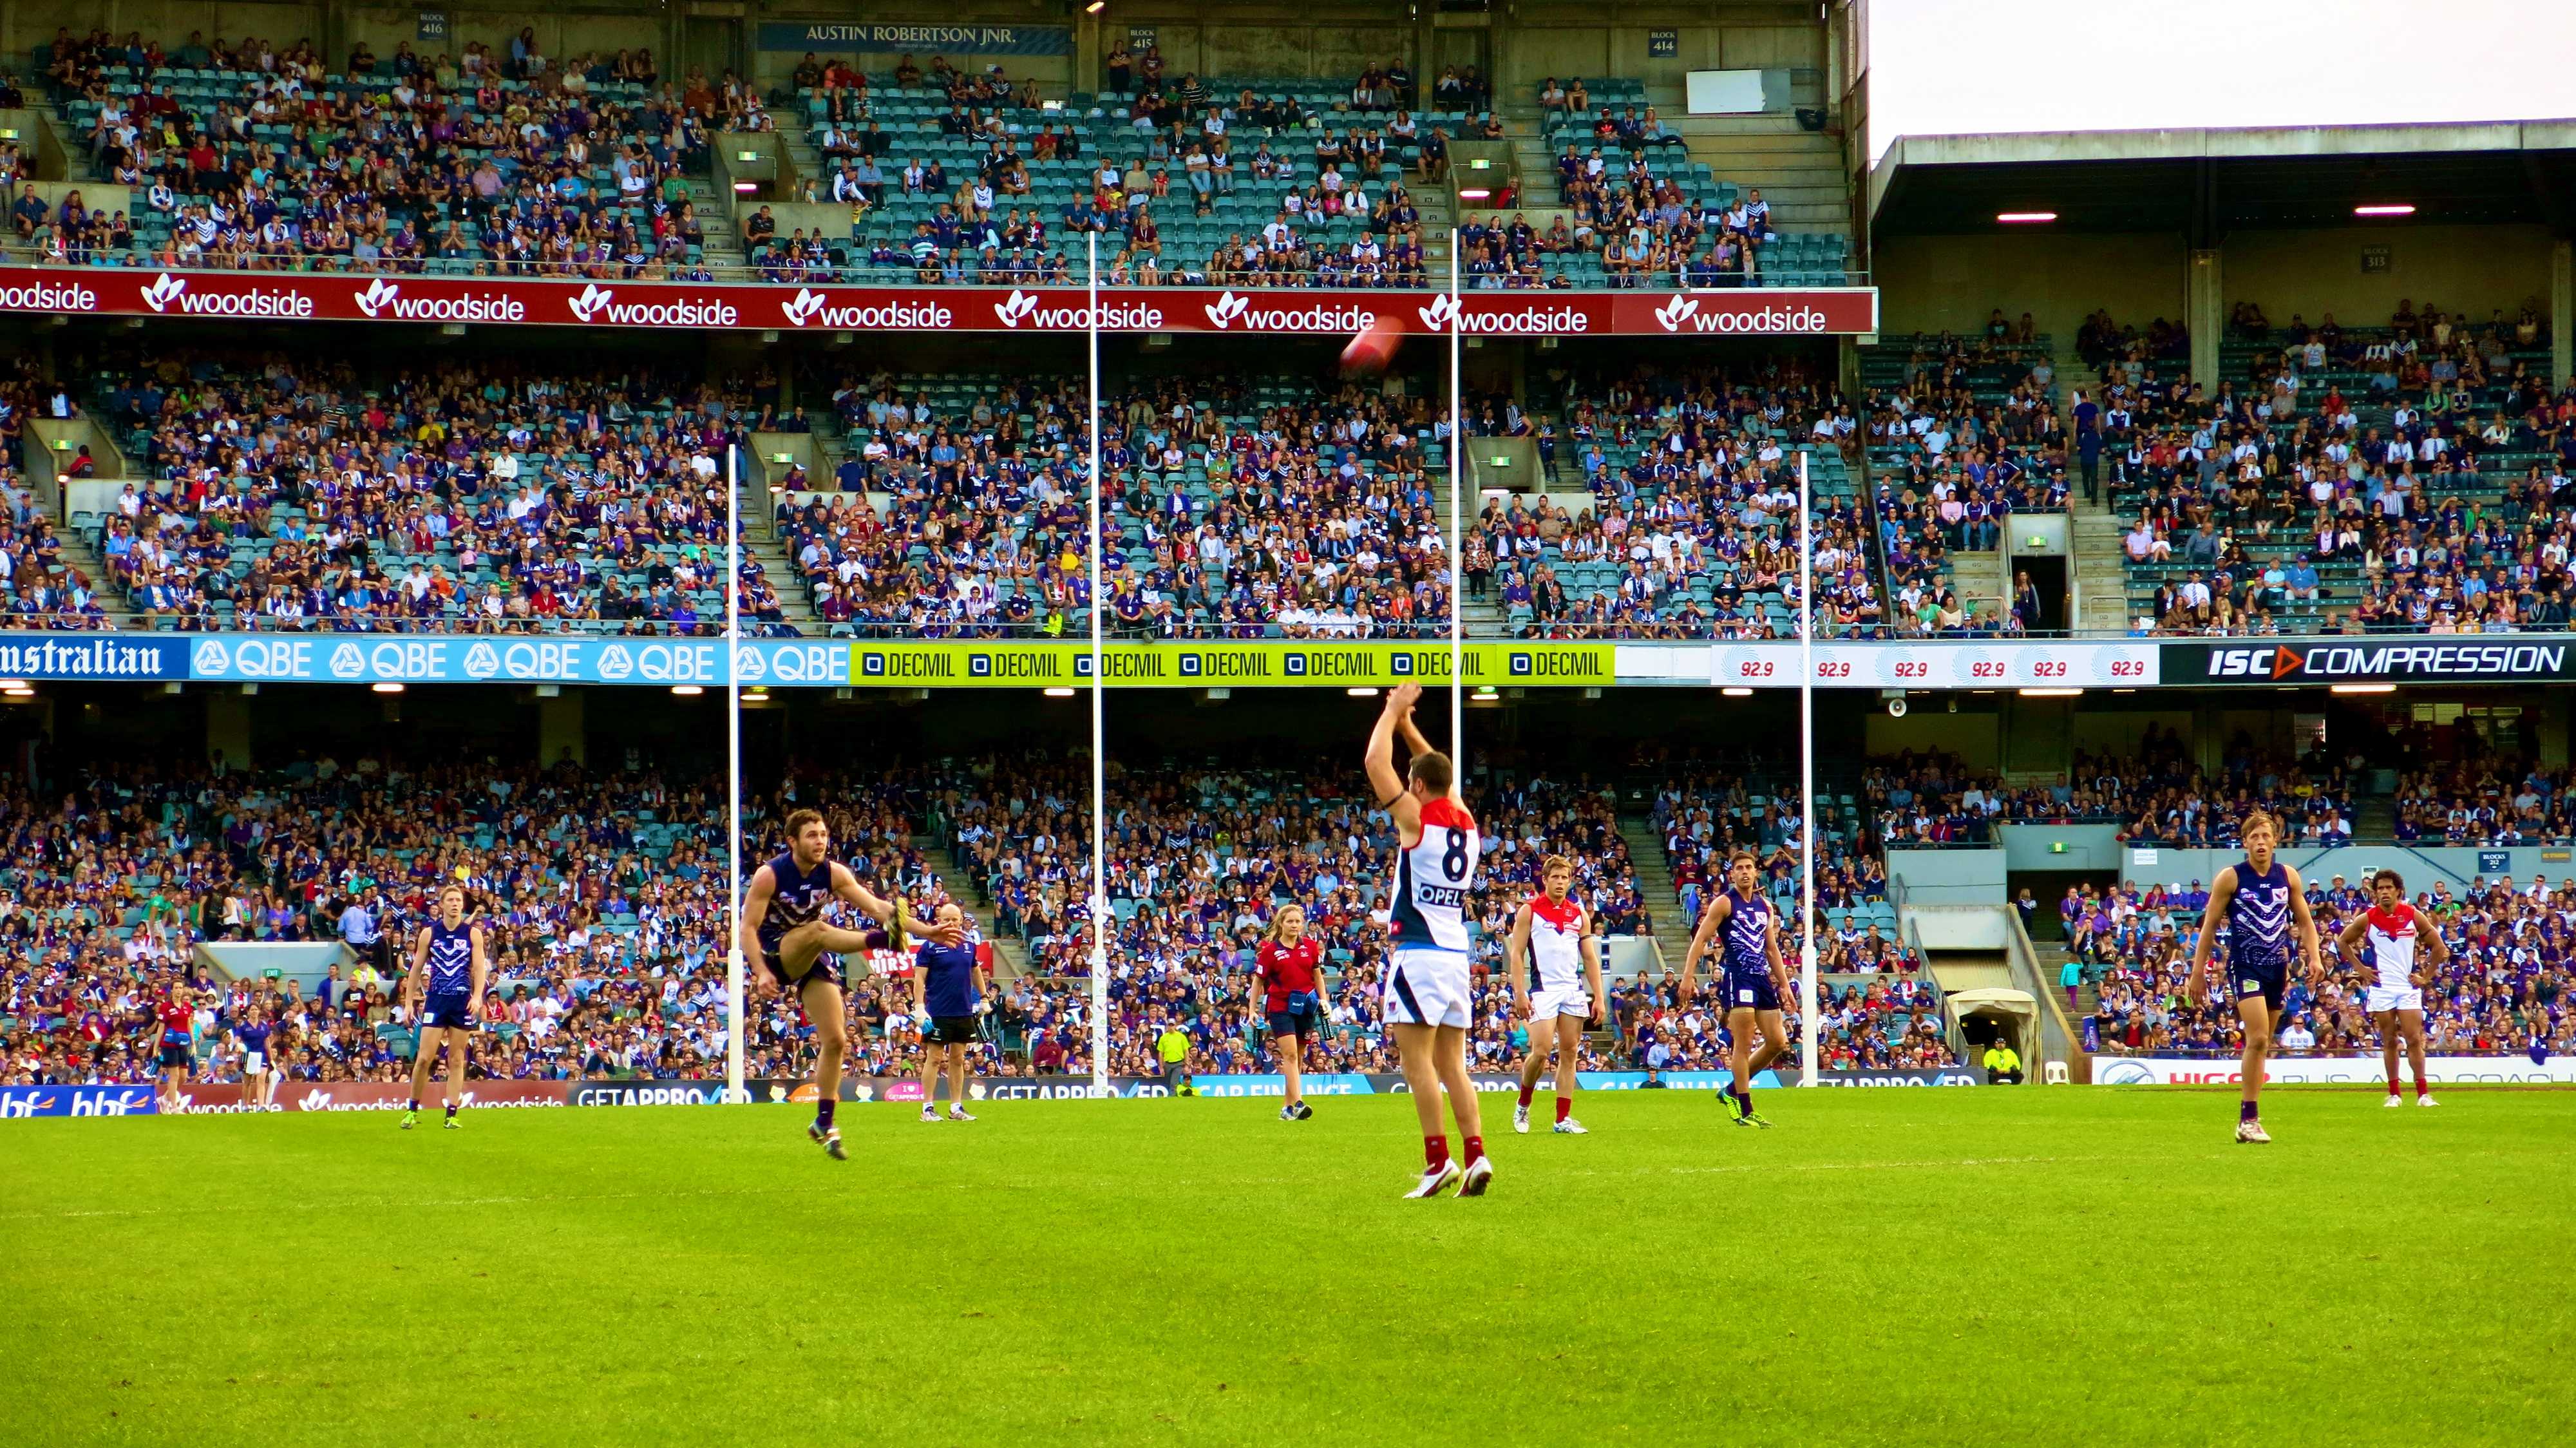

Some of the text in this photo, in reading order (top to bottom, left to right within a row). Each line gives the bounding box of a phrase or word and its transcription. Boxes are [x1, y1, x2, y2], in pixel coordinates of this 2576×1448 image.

[420, 13, 444, 21] BLOCK
[422, 24, 442, 33] 416
[807, 26, 1017, 46] AUSTIN ROBERTSON JNR.
[1133, 39, 1151, 48] 415
[1653, 41, 1674, 50] 414
[0, 281, 95, 310] odside
[180, 289, 313, 316] woodside
[393, 293, 525, 322] woodside
[606, 298, 737, 326] woodside
[819, 301, 951, 327] woodside
[1032, 301, 1162, 329] woodside
[1244, 304, 1375, 331] woodside
[1457, 306, 1587, 332] woodside
[1693, 306, 1826, 333] woodside
[236, 640, 312, 677] QBE
[372, 642, 448, 678] QBE
[505, 643, 580, 679] QBE
[639, 644, 714, 680] QBE
[772, 646, 848, 681] QBE
[889, 653, 955, 677] DECMIL
[996, 653, 1061, 677] DECMIL
[1101, 653, 1166, 677] DECMIL
[1206, 653, 1271, 676] DECMIL
[1311, 653, 1378, 676] DECMIL
[1537, 652, 1603, 676] DECMIL
[1741, 662, 1774, 676] 92.9
[1818, 662, 1850, 677] 92.9
[1895, 662, 1927, 677] 92.9
[1972, 662, 2005, 677] 92.9
[2034, 662, 2067, 676] 92.9
[2111, 661, 2144, 676] 92.9
[2209, 646, 2566, 675] ISC COMPRESSION
[1442, 825, 1468, 882] 8
[1419, 886, 1461, 906] OPEL
[71, 1091, 135, 1117] hbf
